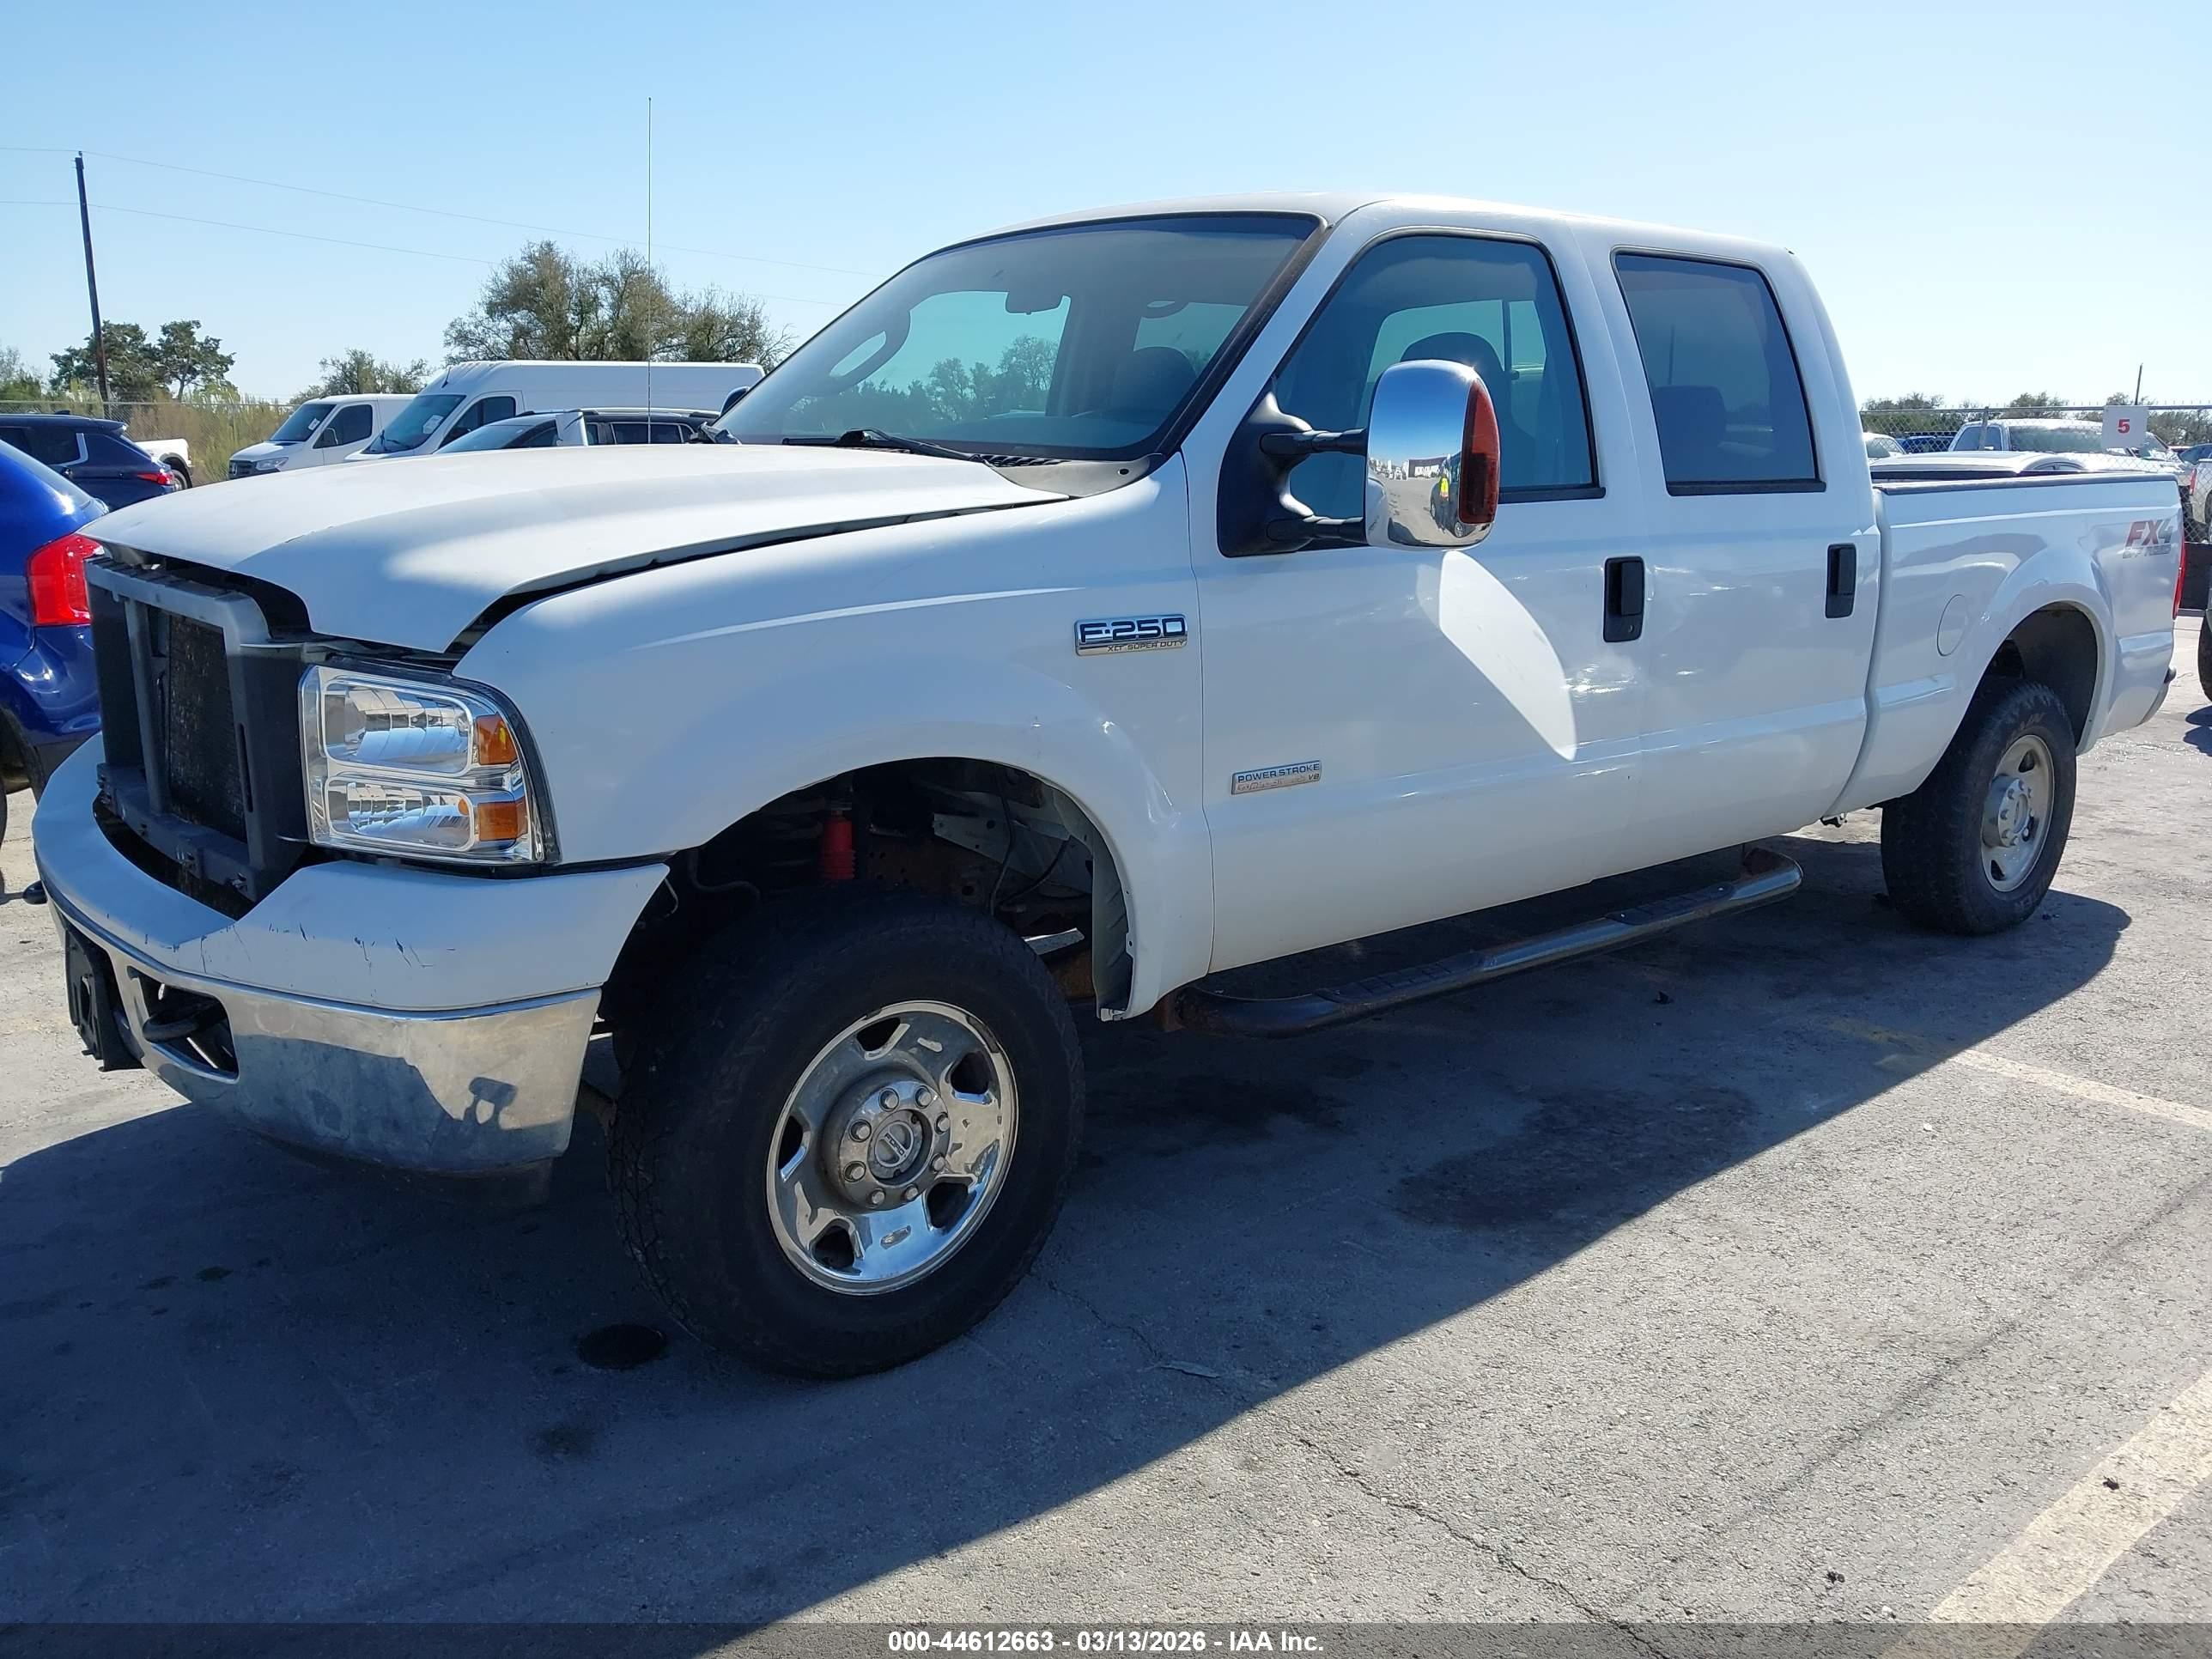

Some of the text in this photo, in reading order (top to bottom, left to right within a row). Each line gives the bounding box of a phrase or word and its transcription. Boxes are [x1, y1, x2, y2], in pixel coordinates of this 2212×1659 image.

[2118, 418, 2130, 434] 5
[2124, 519, 2173, 548] FX4
[1127, 642, 1158, 651] SUPER
[1159, 640, 1186, 648] DUTY
[884, 1132, 906, 1157] FORD
